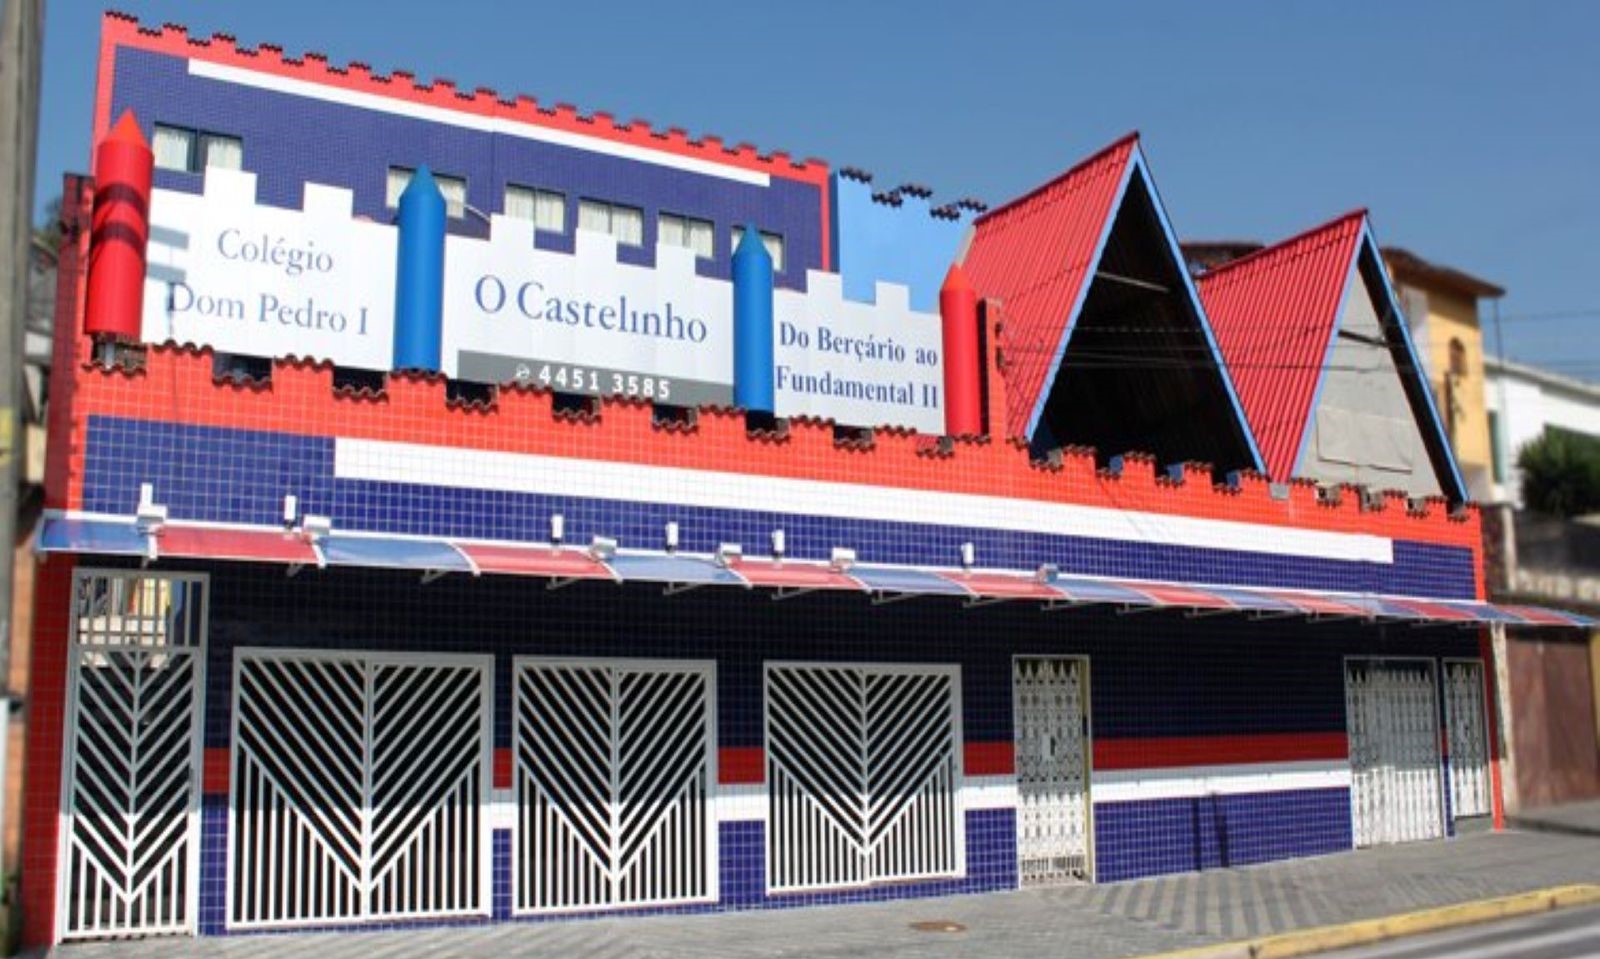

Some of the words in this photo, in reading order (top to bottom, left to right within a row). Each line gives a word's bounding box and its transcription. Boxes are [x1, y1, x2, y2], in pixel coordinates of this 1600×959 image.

[217, 228, 334, 275] Colégio
[168, 282, 245, 320] Dom
[258, 293, 347, 333] Pedro
[357, 306, 369, 336] I
[475, 274, 506, 313] O
[517, 281, 707, 343] Castelinho
[779, 321, 809, 348] Do
[817, 326, 906, 363] Berçário
[915, 348, 938, 366] ao
[538, 364, 600, 391] 4451
[611, 373, 671, 399] 3585
[776, 364, 914, 405] Fundamental
[922, 383, 938, 408] II
